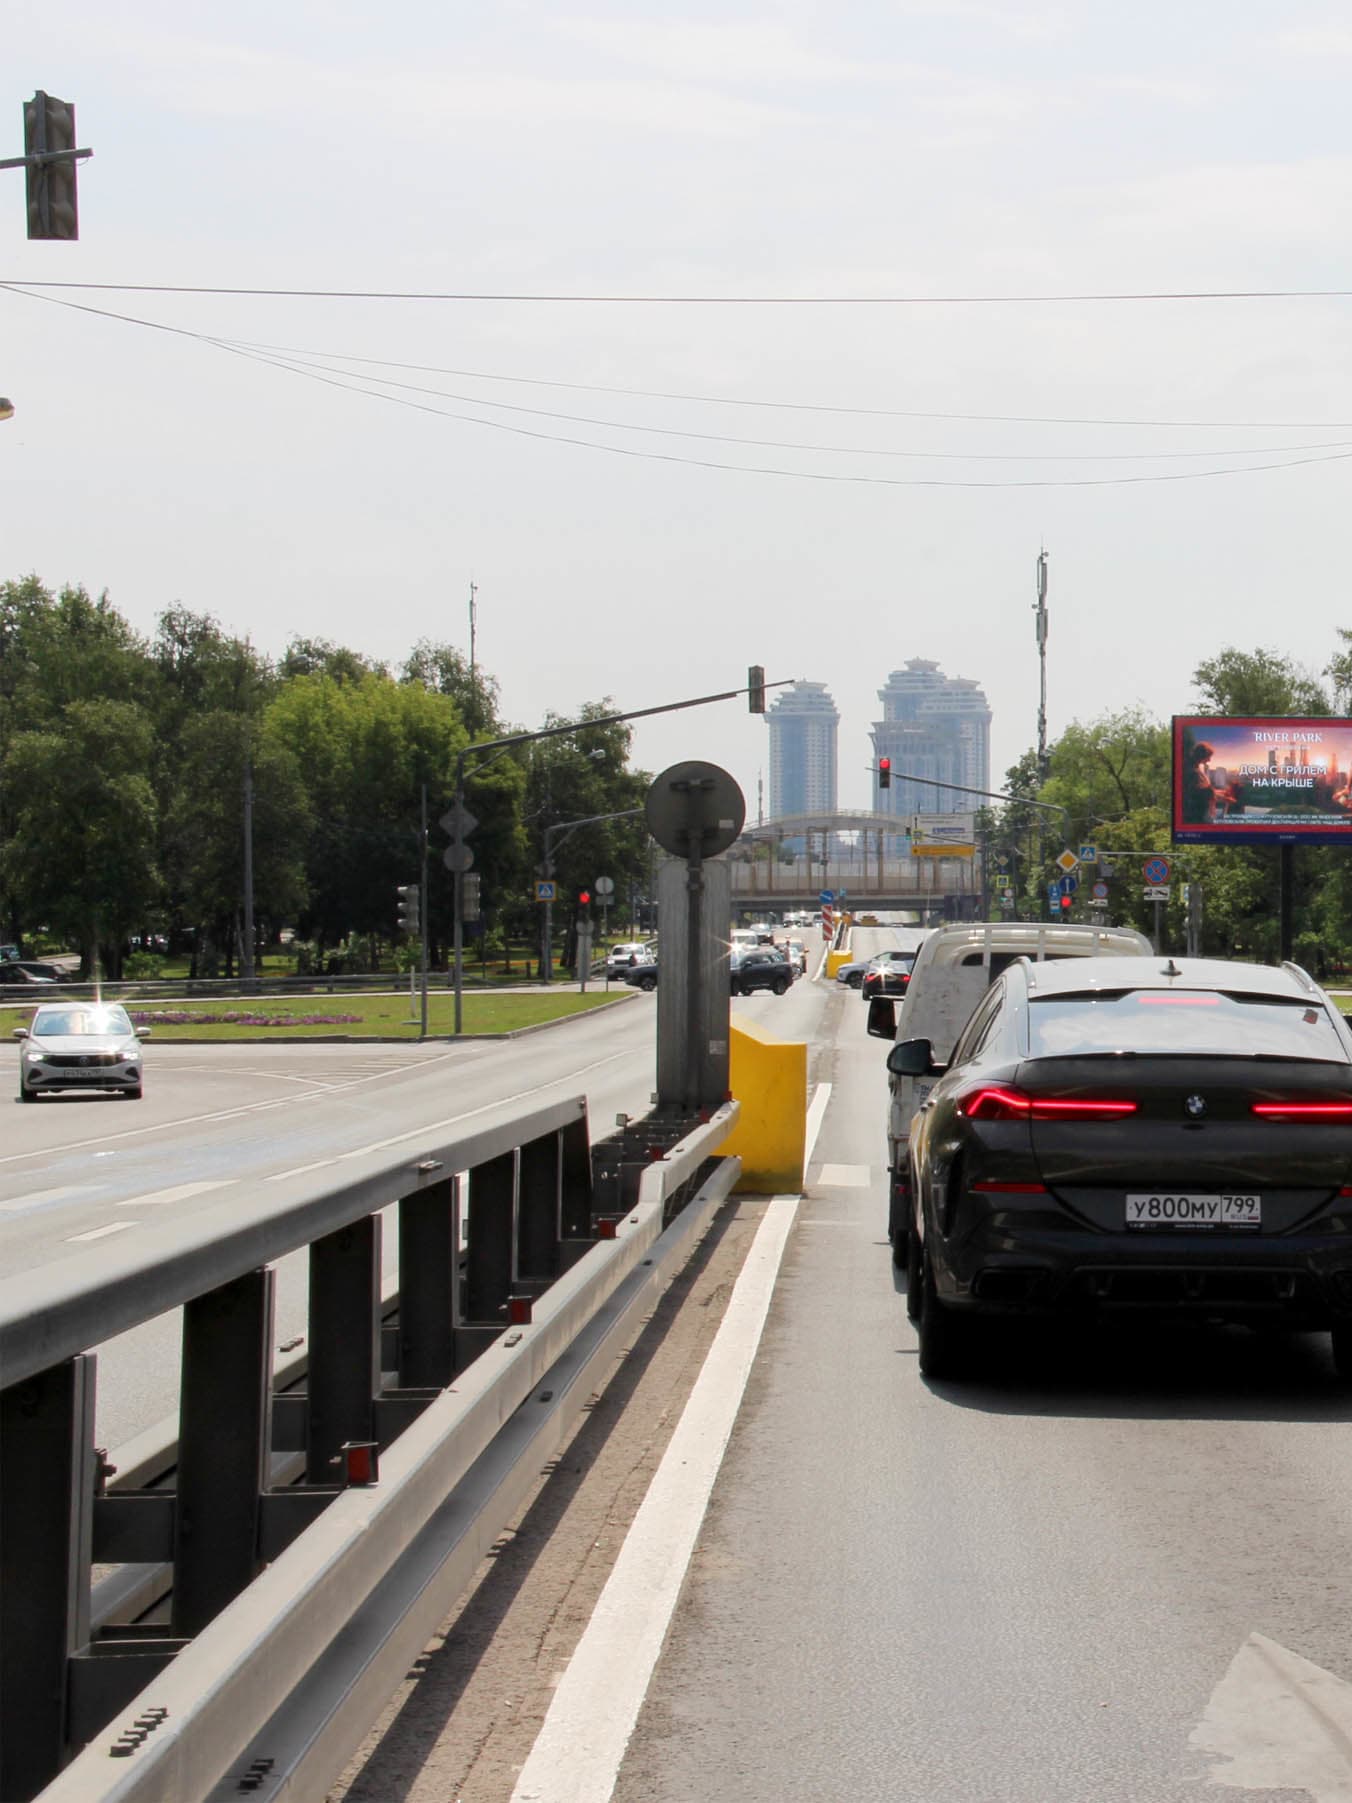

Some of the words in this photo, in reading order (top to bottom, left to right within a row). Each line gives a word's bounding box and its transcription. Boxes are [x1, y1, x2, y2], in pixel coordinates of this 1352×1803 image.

[1254, 732, 1289, 742] RIVER
[1293, 732, 1323, 742] PARK
[1239, 765, 1267, 776] ДОМ
[1269, 765, 1278, 775] С
[1280, 765, 1327, 775] ГРИЛЕМ
[1252, 778, 1269, 788] НА
[1271, 778, 1314, 788] КРЫШЕ
[1134, 1197, 1218, 1218] У800МУ
[1223, 1197, 1256, 1213] 799
